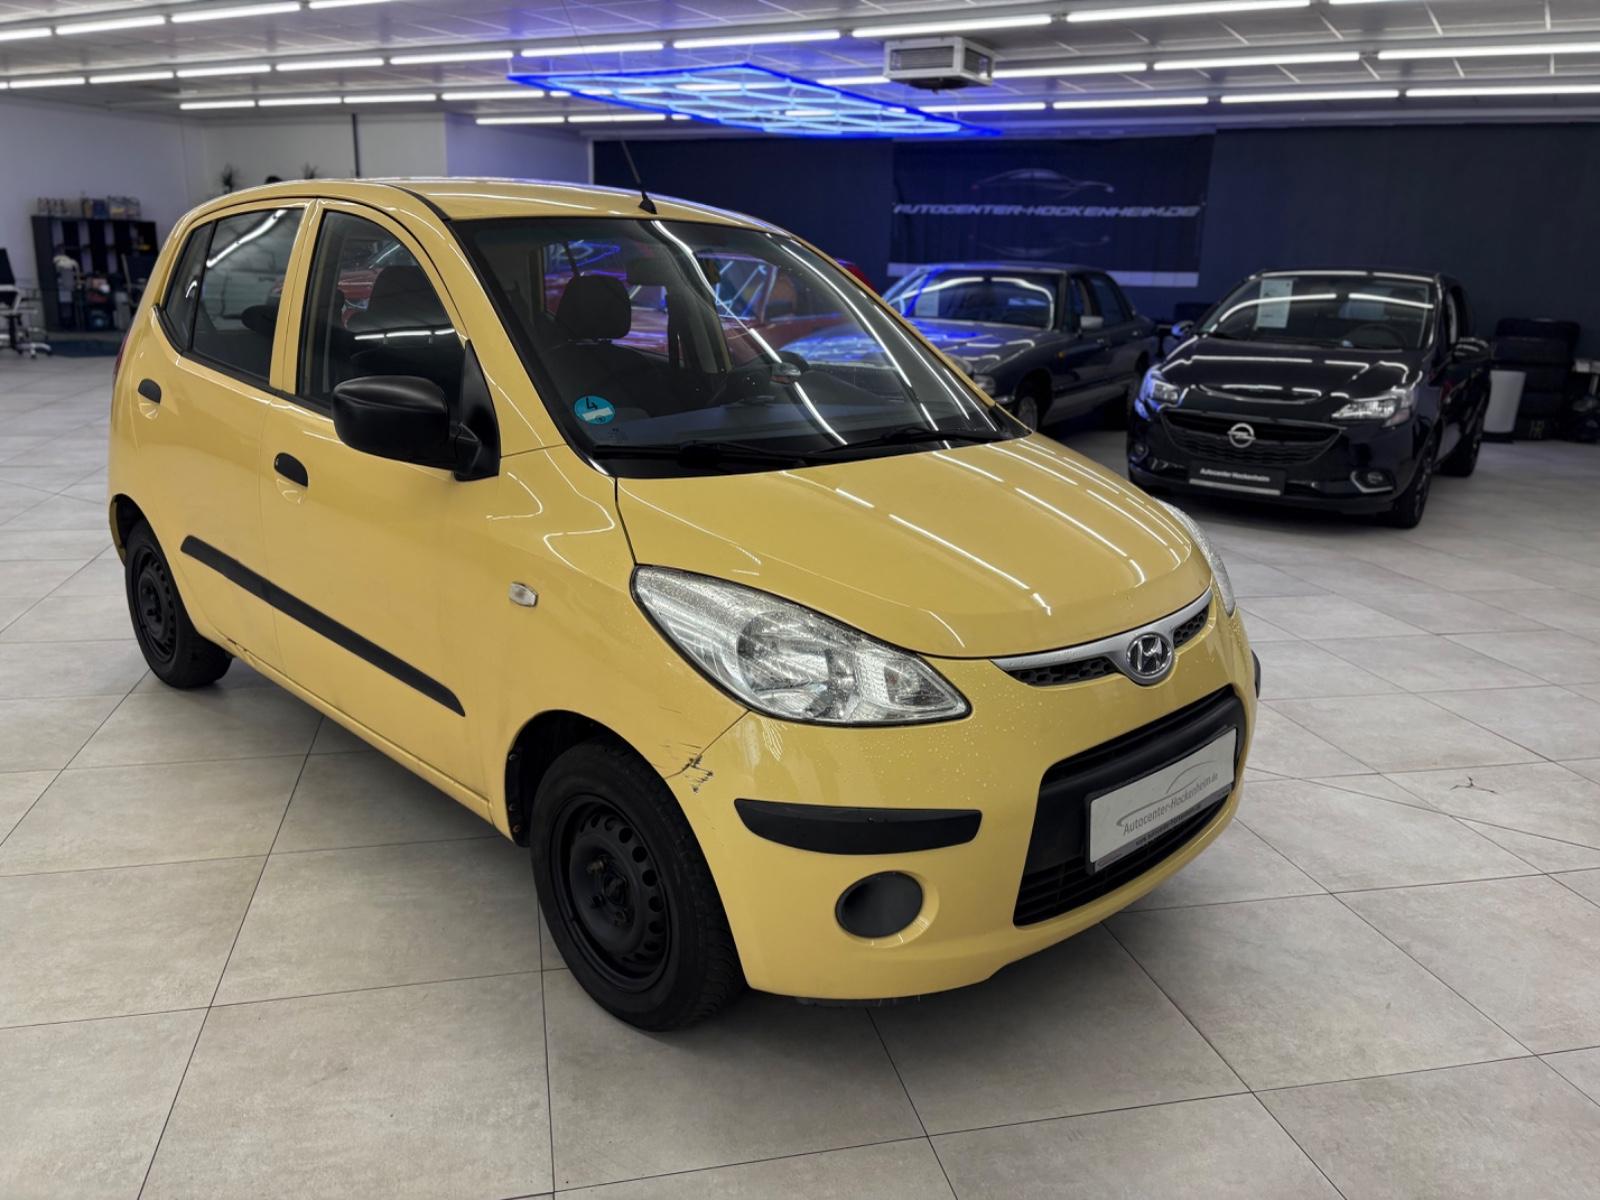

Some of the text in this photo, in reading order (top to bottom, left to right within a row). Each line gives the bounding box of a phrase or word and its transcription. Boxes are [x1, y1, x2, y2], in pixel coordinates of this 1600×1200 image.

[893, 203, 1200, 217] AUTOCENTER-HOCKENHEIM.DE
[585, 396, 598, 410] 4
[1123, 772, 1219, 837] Autocenter-Hockenheim.de
